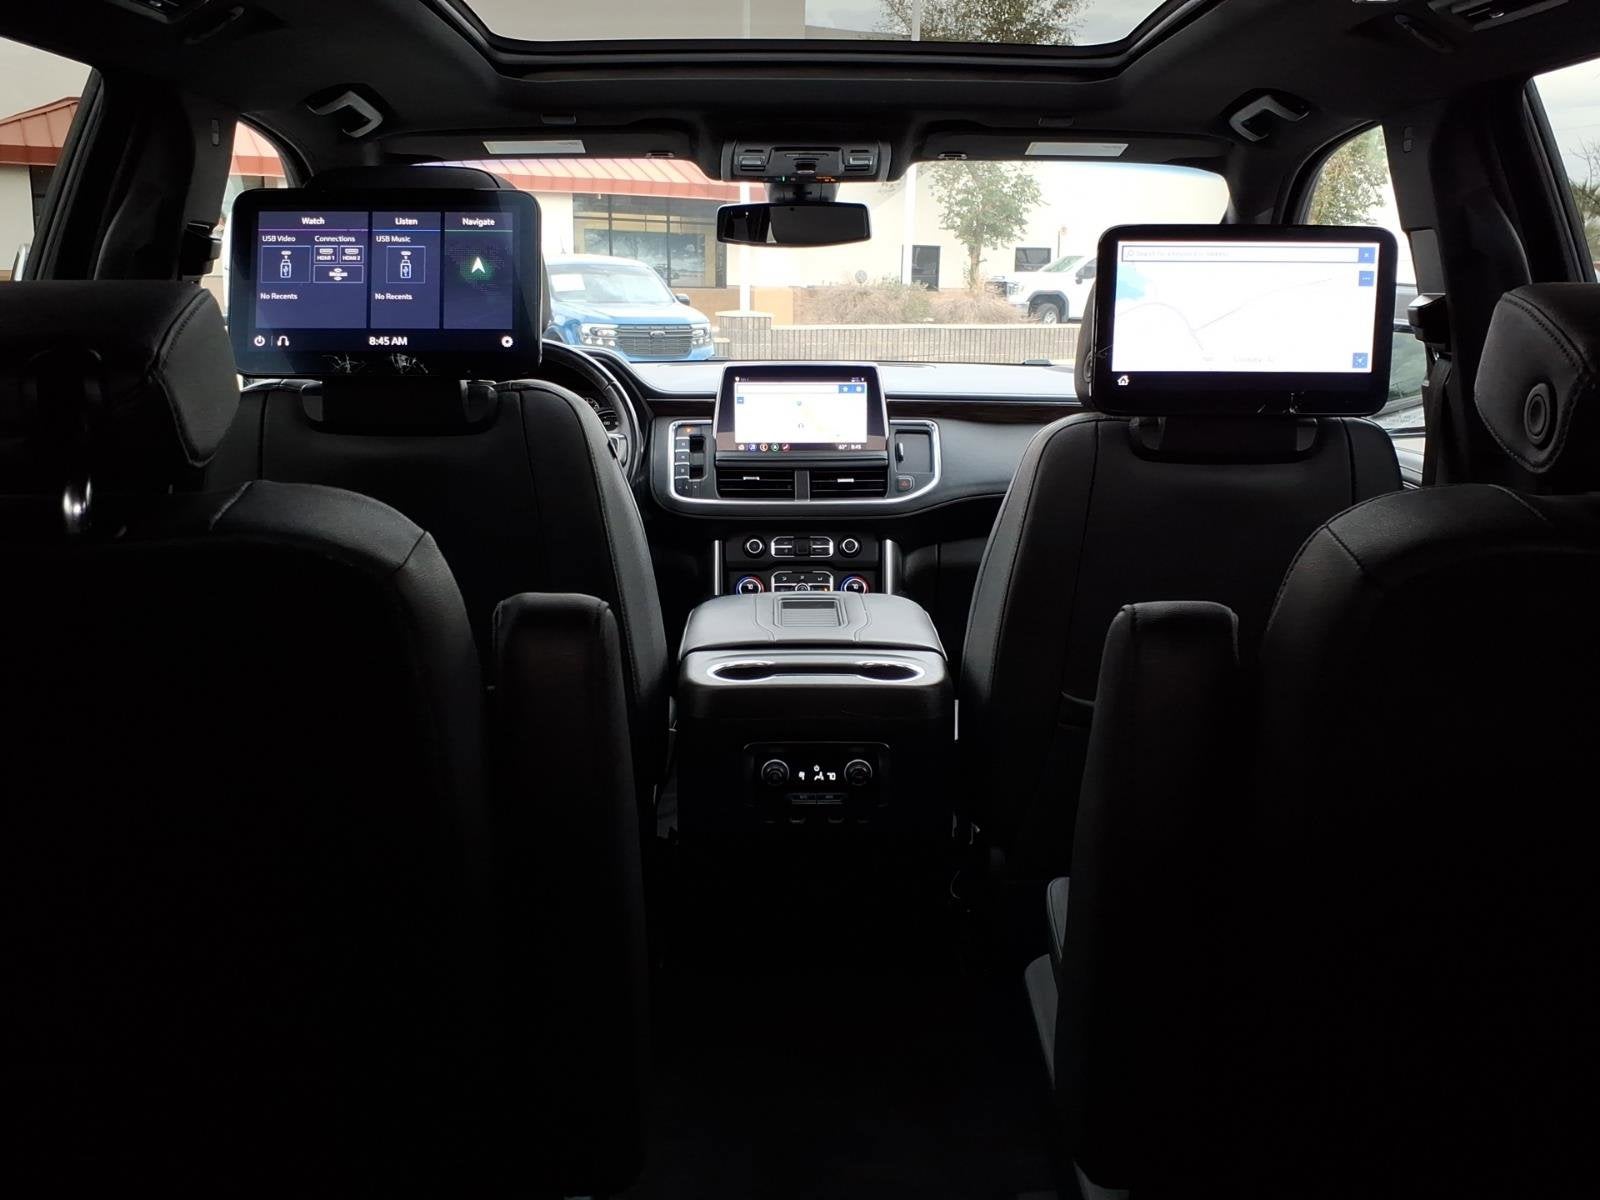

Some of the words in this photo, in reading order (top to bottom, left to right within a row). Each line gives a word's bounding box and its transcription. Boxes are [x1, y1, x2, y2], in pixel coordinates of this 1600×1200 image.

[301, 216, 325, 225] Watch
[395, 217, 418, 226] Listen
[462, 217, 495, 227] Navigate
[314, 235, 355, 243] Connections
[376, 235, 389, 243] USB
[391, 235, 411, 243] Music
[386, 293, 413, 301] Recents
[369, 337, 390, 346] 8:45
[391, 337, 408, 346] AM
